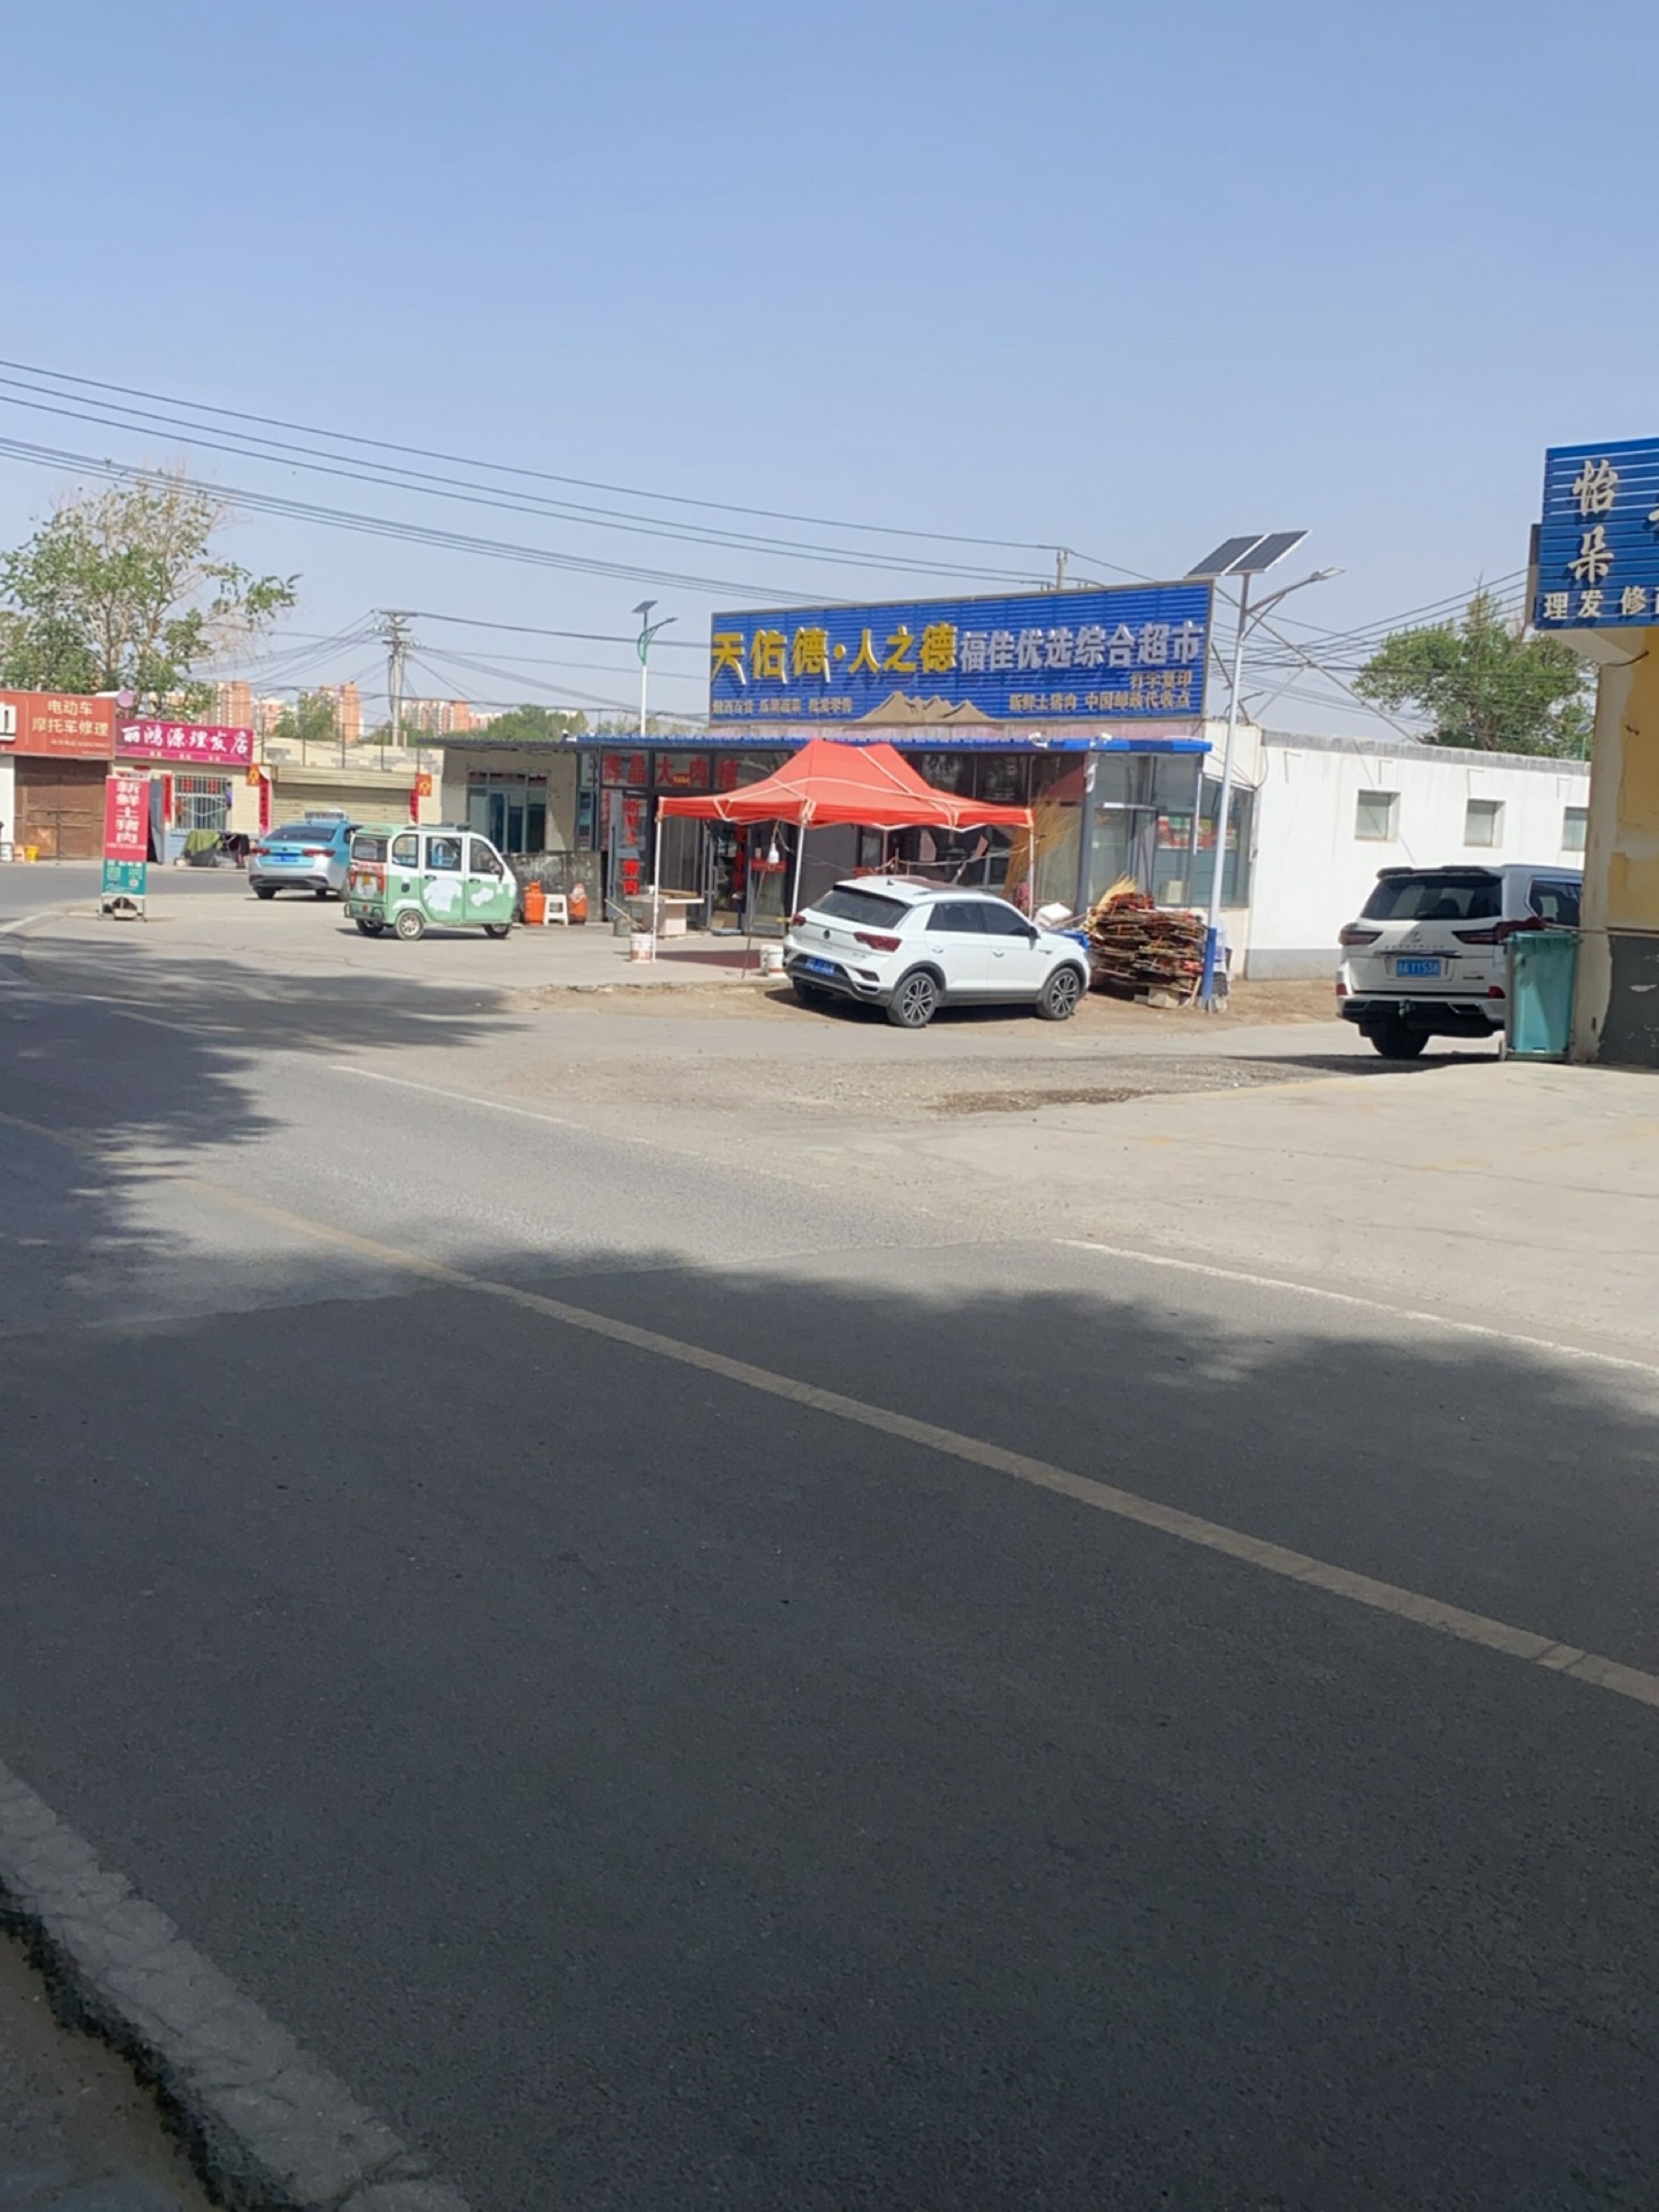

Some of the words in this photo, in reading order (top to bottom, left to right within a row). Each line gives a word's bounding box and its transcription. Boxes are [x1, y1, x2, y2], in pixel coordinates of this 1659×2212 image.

[1567, 459, 1618, 583] 怡朵
[711, 621, 958, 685] 天佑德·人之德
[961, 620, 1204, 673] 福佳优选综合超市
[32, 717, 109, 737] 摩托车修理
[47, 700, 93, 716] 电动车
[120, 724, 249, 754] 丽鸿源理发店
[115, 781, 141, 844] 新鲜土猪肉
